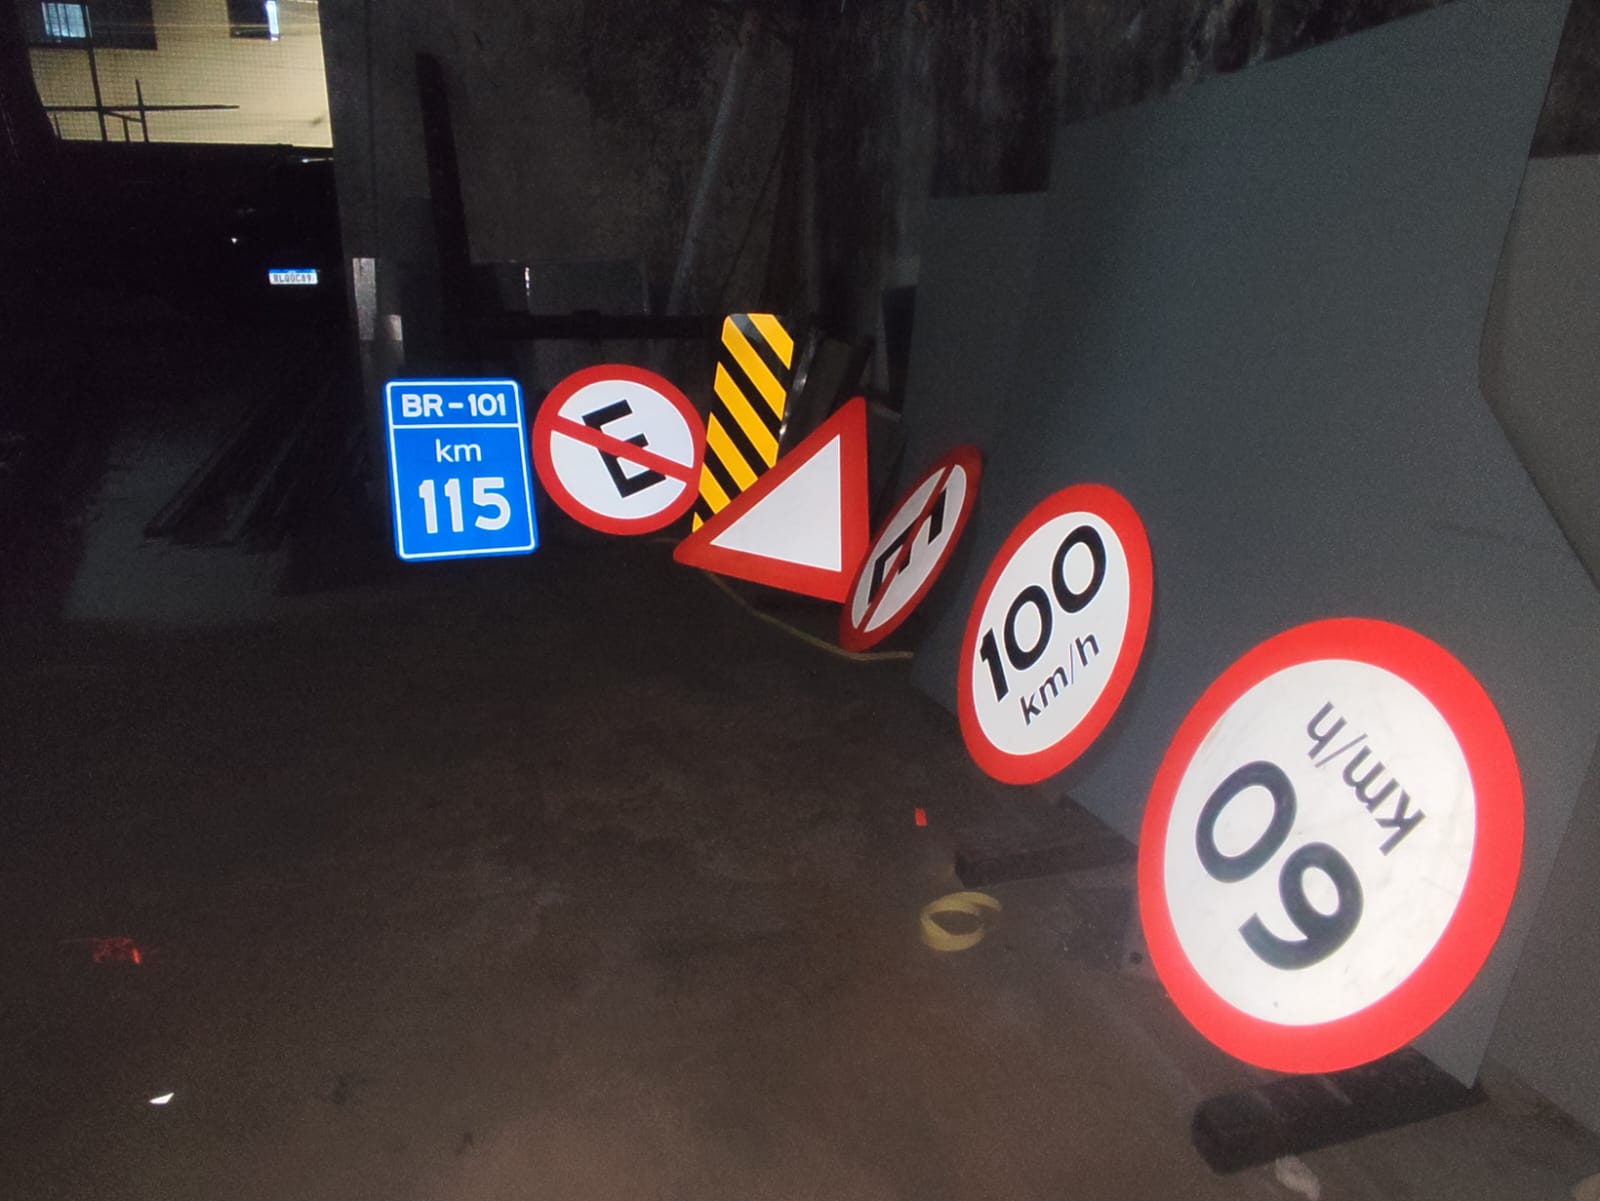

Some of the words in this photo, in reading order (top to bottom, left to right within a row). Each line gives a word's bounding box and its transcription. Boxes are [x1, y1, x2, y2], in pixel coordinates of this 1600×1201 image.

[401, 393, 507, 418] BR-101
[435, 439, 483, 463] km
[582, 398, 667, 499] E
[418, 477, 512, 534] 115
[979, 525, 1107, 703] 100
[1020, 631, 1101, 726] km/h
[1307, 700, 1426, 856] km/h
[1195, 759, 1365, 971] 60
